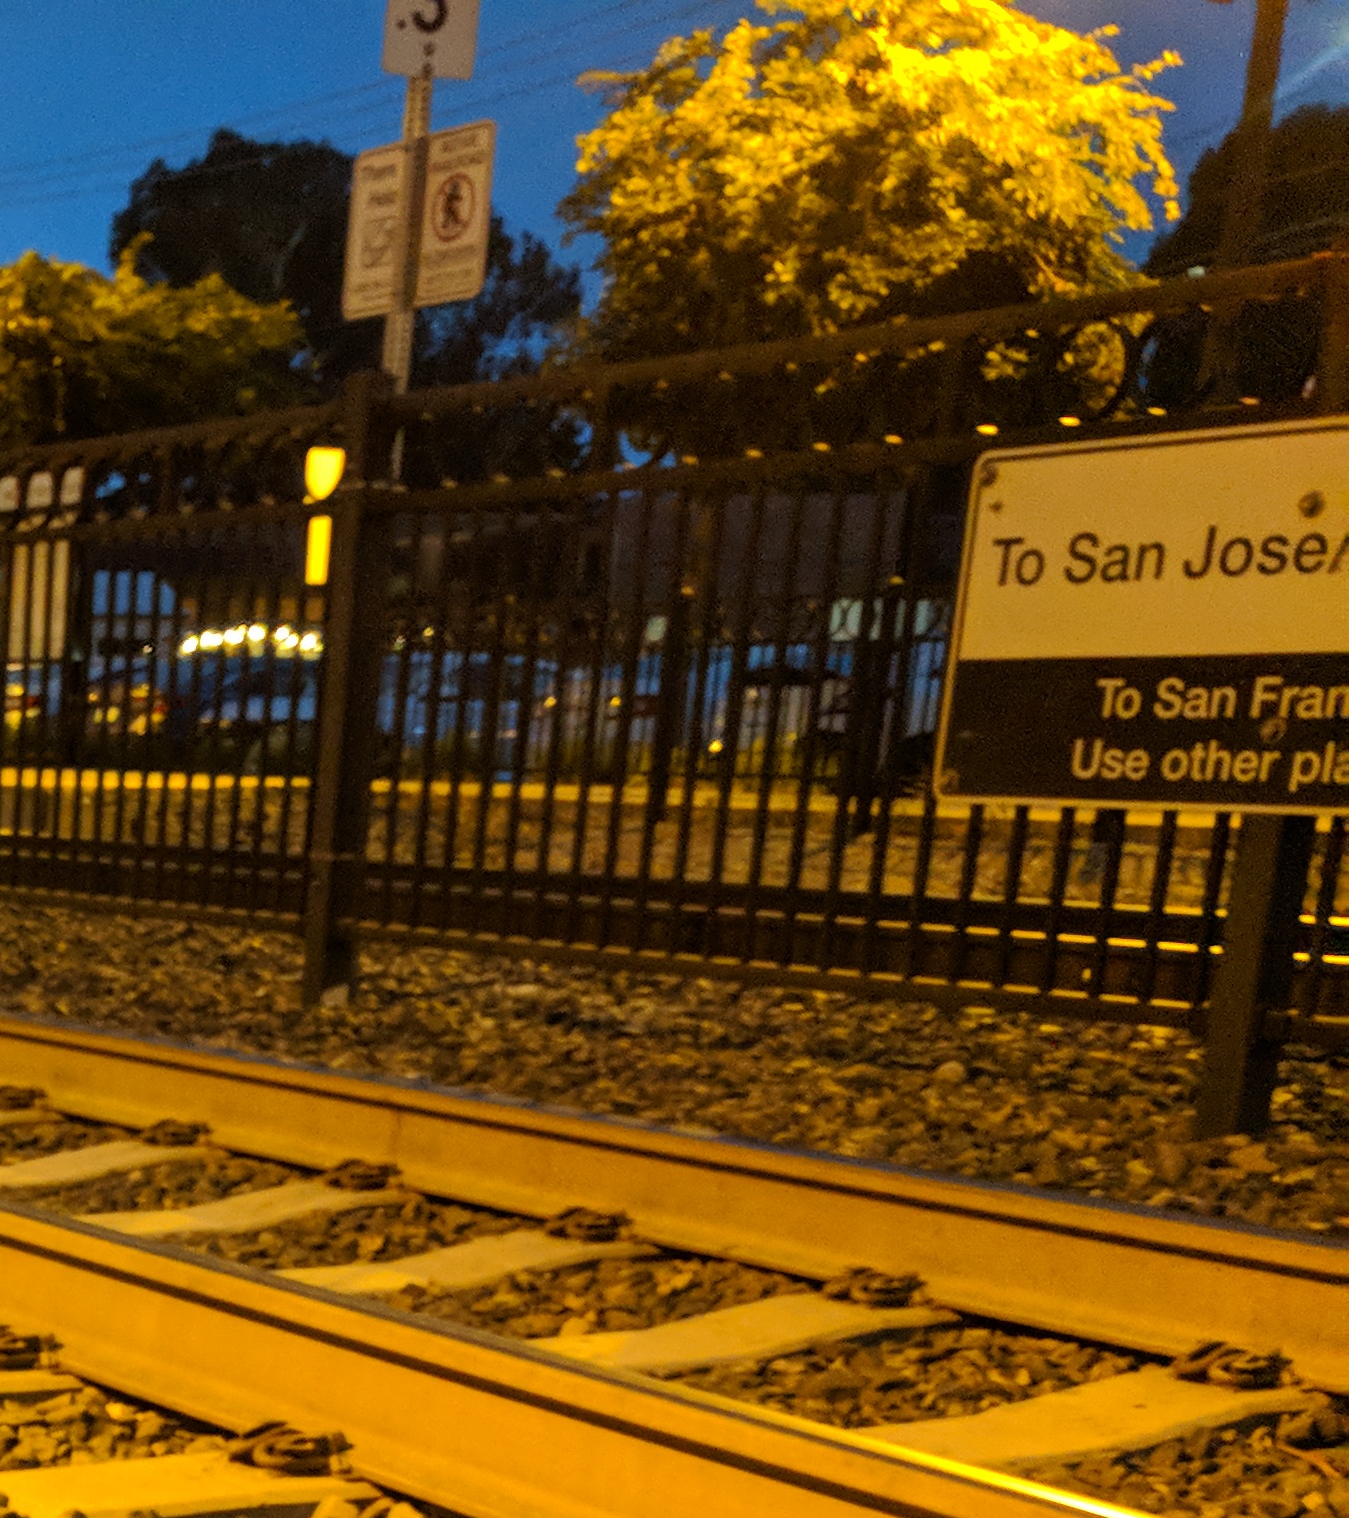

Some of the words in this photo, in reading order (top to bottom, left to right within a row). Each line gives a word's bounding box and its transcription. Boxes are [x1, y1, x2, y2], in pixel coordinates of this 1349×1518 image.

[993, 536, 1046, 587] To
[1063, 531, 1166, 584] San
[1096, 677, 1142, 719] To
[1153, 676, 1237, 719] San
[1071, 738, 1150, 780] Use
[1161, 739, 1281, 782] other
